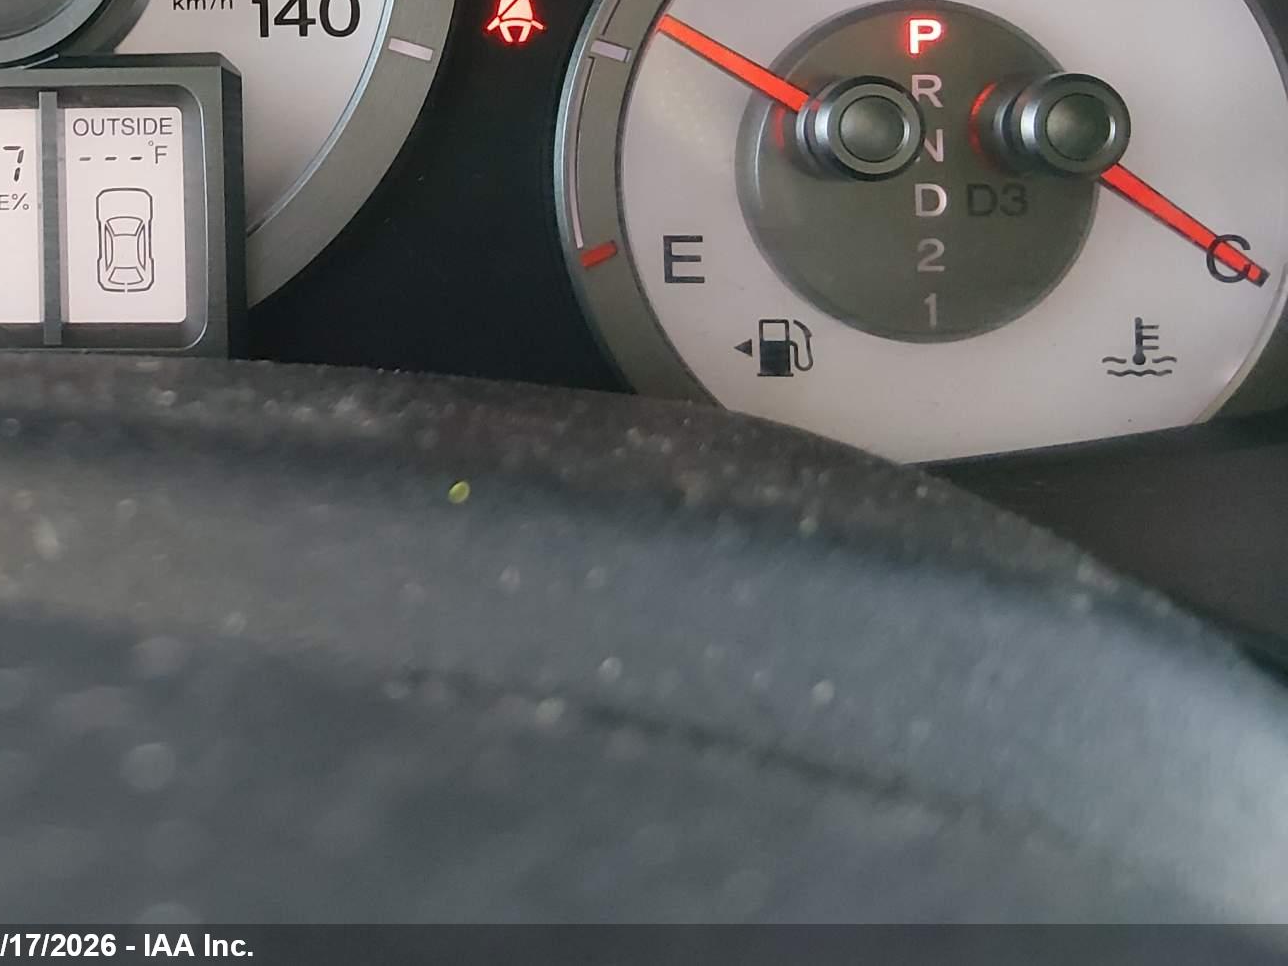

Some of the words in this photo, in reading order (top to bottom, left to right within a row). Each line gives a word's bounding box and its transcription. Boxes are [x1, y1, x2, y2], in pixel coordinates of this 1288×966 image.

[910, 19, 943, 54] P
[914, 75, 943, 108] R
[72, 117, 173, 137] OUTSIDE
[914, 129, 945, 163] N
[915, 183, 947, 217] D
[967, 184, 1027, 217] D3
[663, 235, 705, 284] E
[916, 239, 945, 273] 2
[1206, 234, 1252, 283] C
[923, 293, 938, 326] 1
